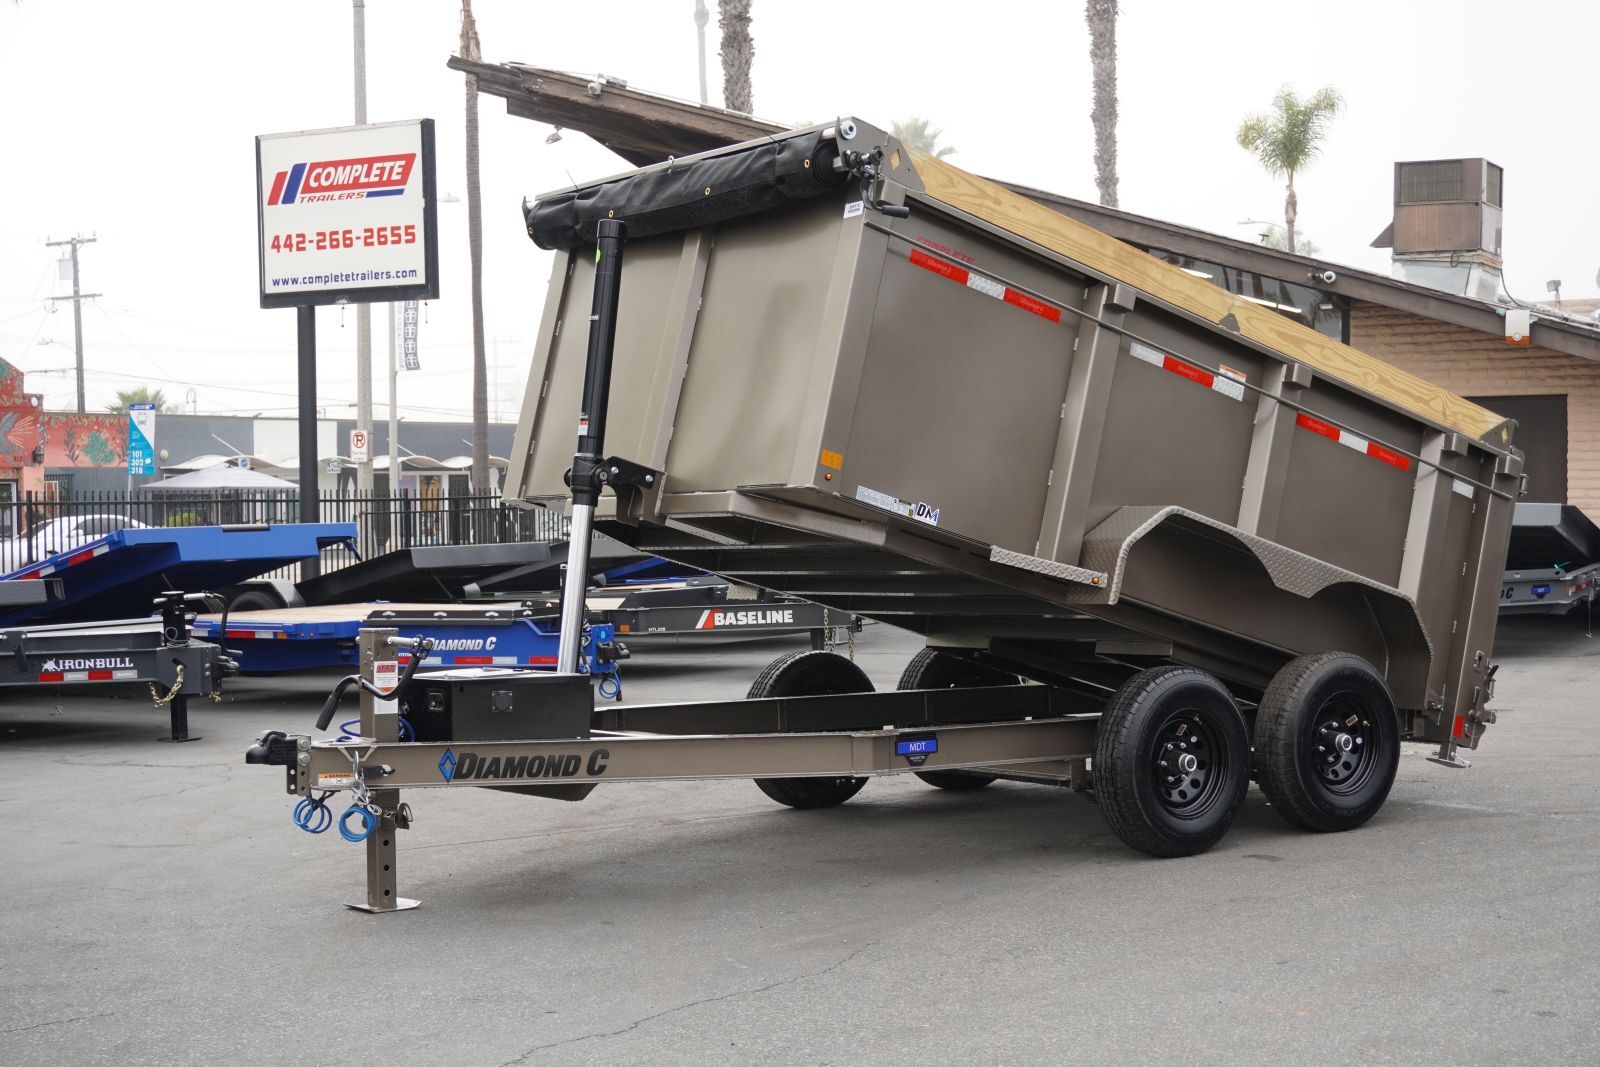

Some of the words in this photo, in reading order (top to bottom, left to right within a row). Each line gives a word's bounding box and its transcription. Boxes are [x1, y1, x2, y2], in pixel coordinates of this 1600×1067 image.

[309, 160, 406, 188] COMPLETE
[300, 191, 366, 204] TRAILERS
[271, 225, 416, 253] 442-266-2655
[272, 268, 417, 286] www.completetrailers.com
[132, 450, 143, 458] 101
[713, 610, 794, 626] BASELINE
[485, 636, 497, 651] C
[60, 658, 134, 670] IRONBULL
[909, 742, 926, 751] MDT
[452, 752, 581, 779] DIAMOND
[587, 749, 610, 776] C
